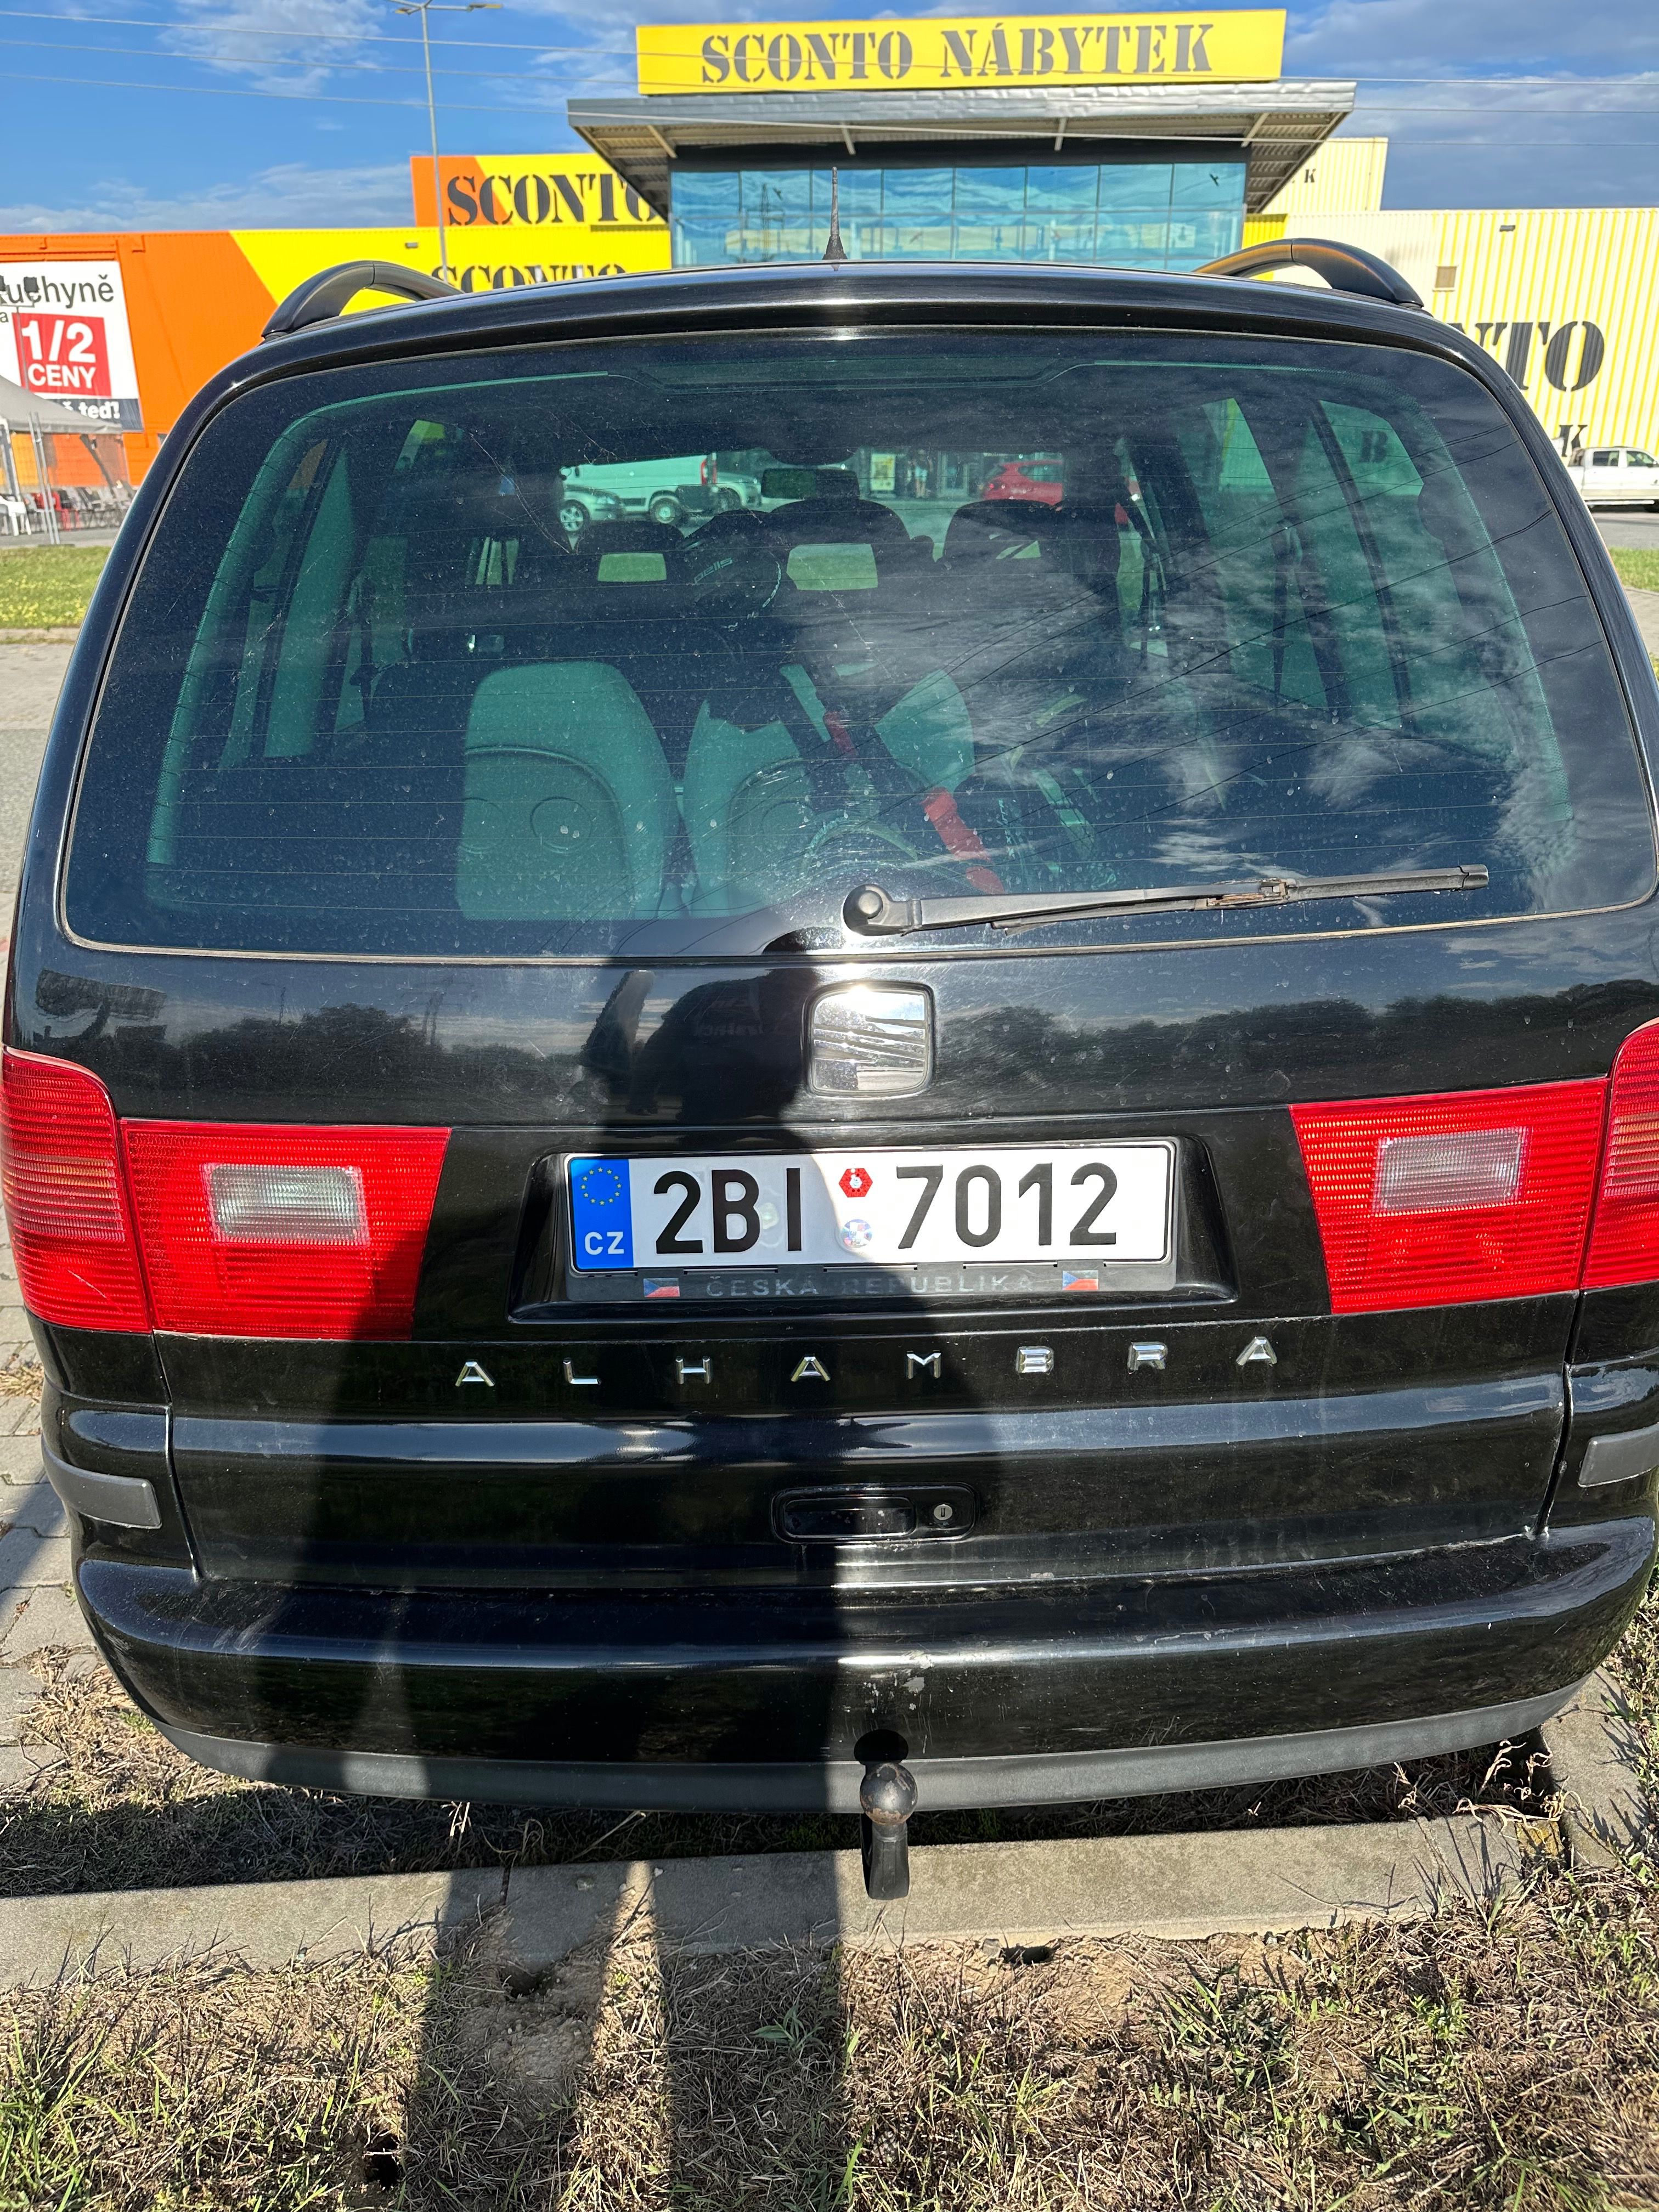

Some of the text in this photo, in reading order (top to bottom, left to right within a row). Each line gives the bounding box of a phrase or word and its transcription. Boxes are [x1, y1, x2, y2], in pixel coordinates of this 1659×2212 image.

[702, 23, 1214, 83] SCONTO NÁBYTEK
[21, 320, 96, 363] 1/2
[28, 364, 96, 388] CENY
[653, 1162, 1118, 1254] 2BI 7012
[584, 1231, 625, 1255] CZ
[706, 1275, 1034, 1296] ČESKÁ REPUBLIKA
[455, 1336, 1278, 1387] ALHAMBRA
